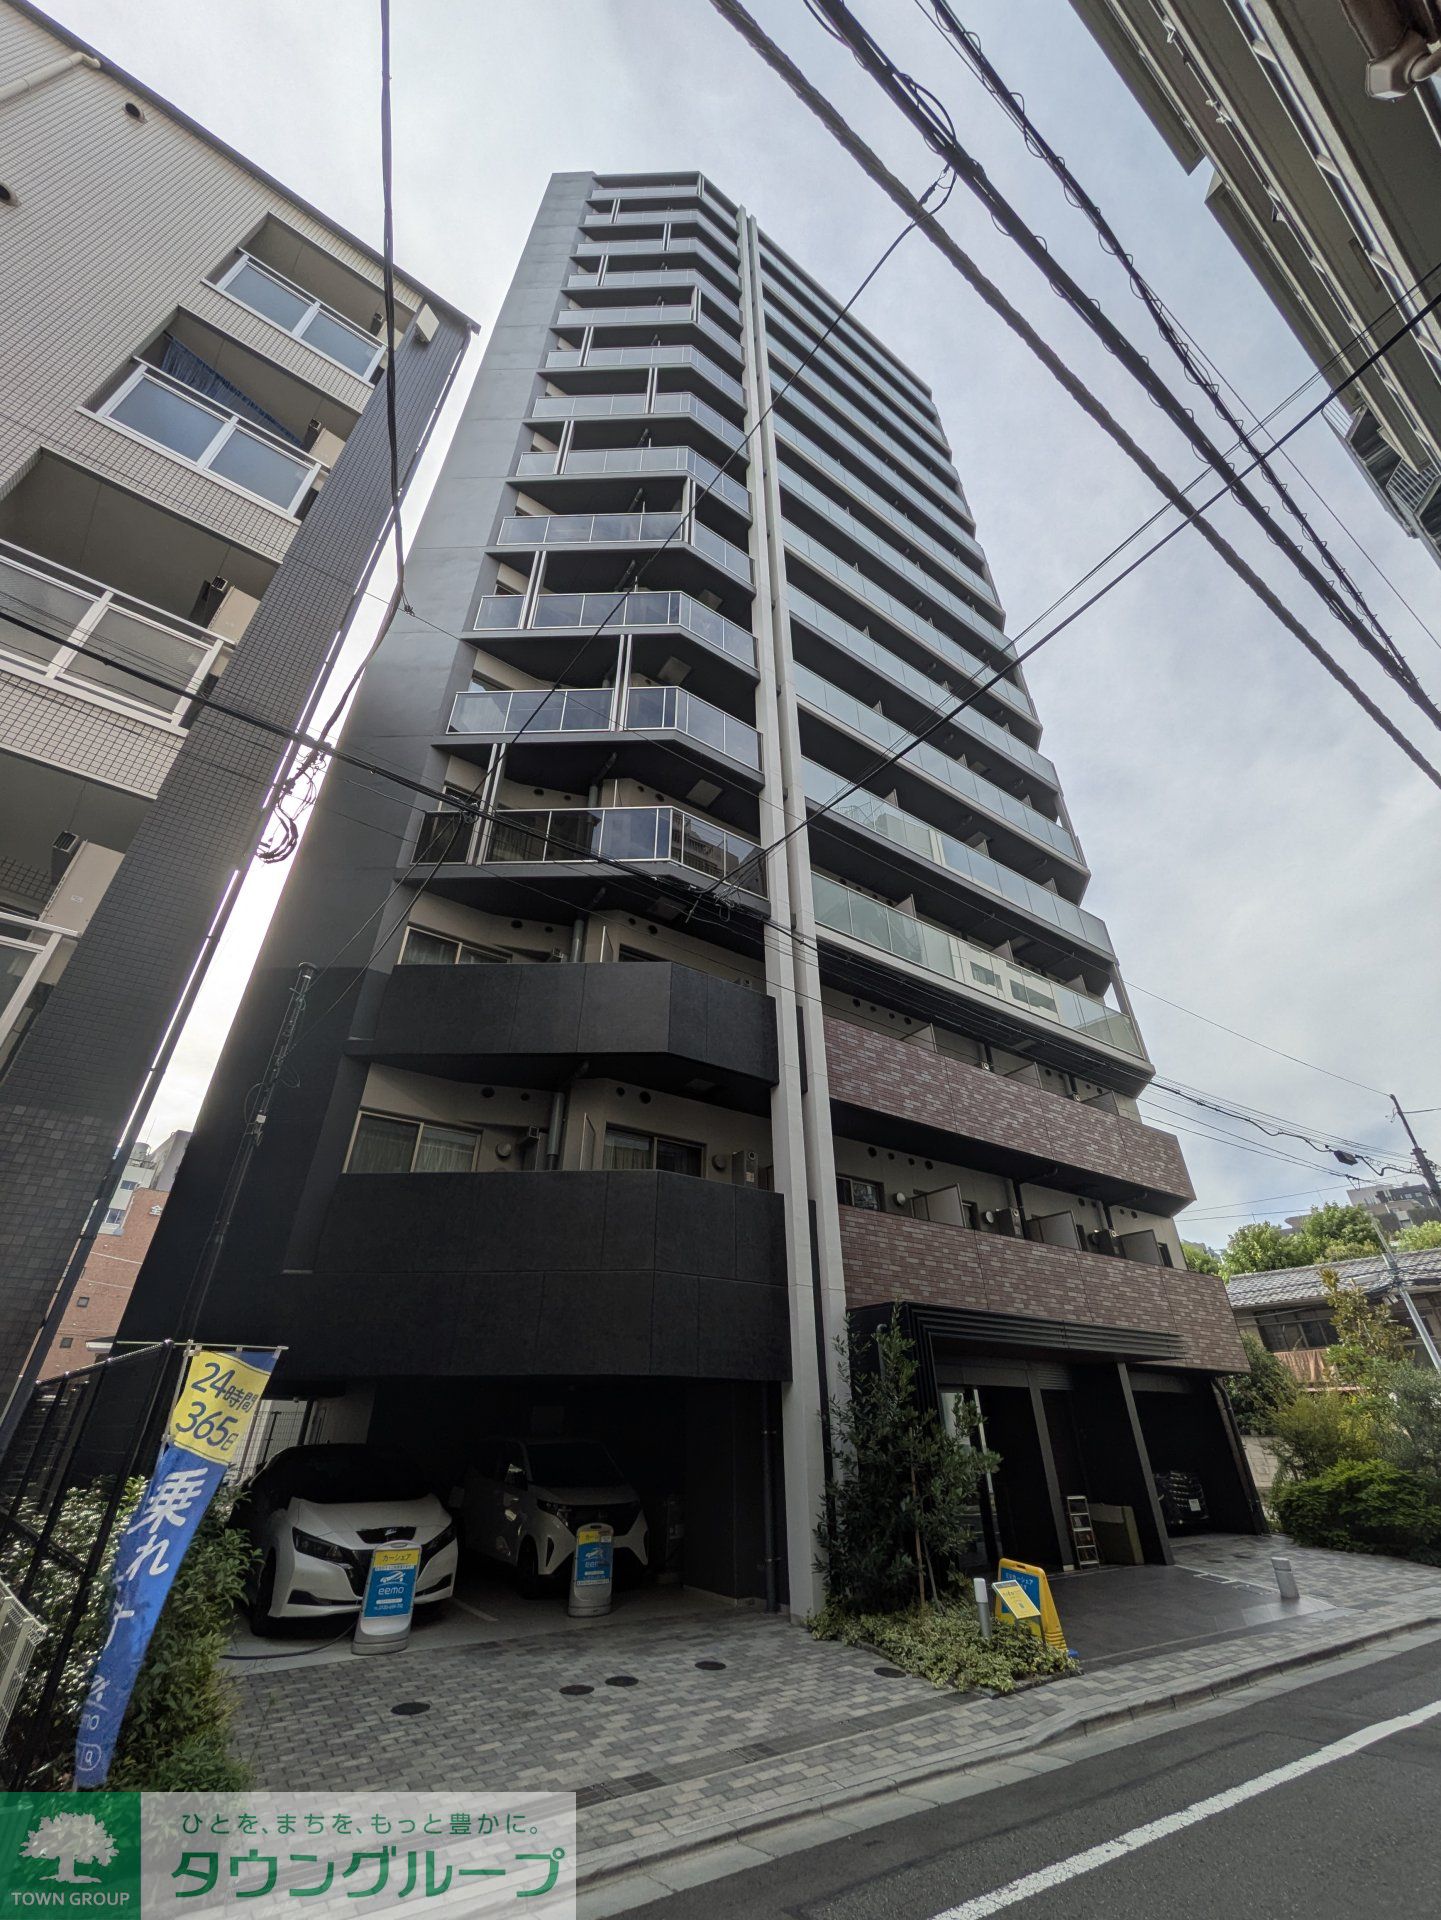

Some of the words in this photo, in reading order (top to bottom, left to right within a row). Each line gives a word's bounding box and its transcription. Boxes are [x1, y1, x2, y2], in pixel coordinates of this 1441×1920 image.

[191, 1362, 259, 1413] 24時間
[176, 1401, 239, 1450] 365日
[378, 1586, 405, 1595] eemo
